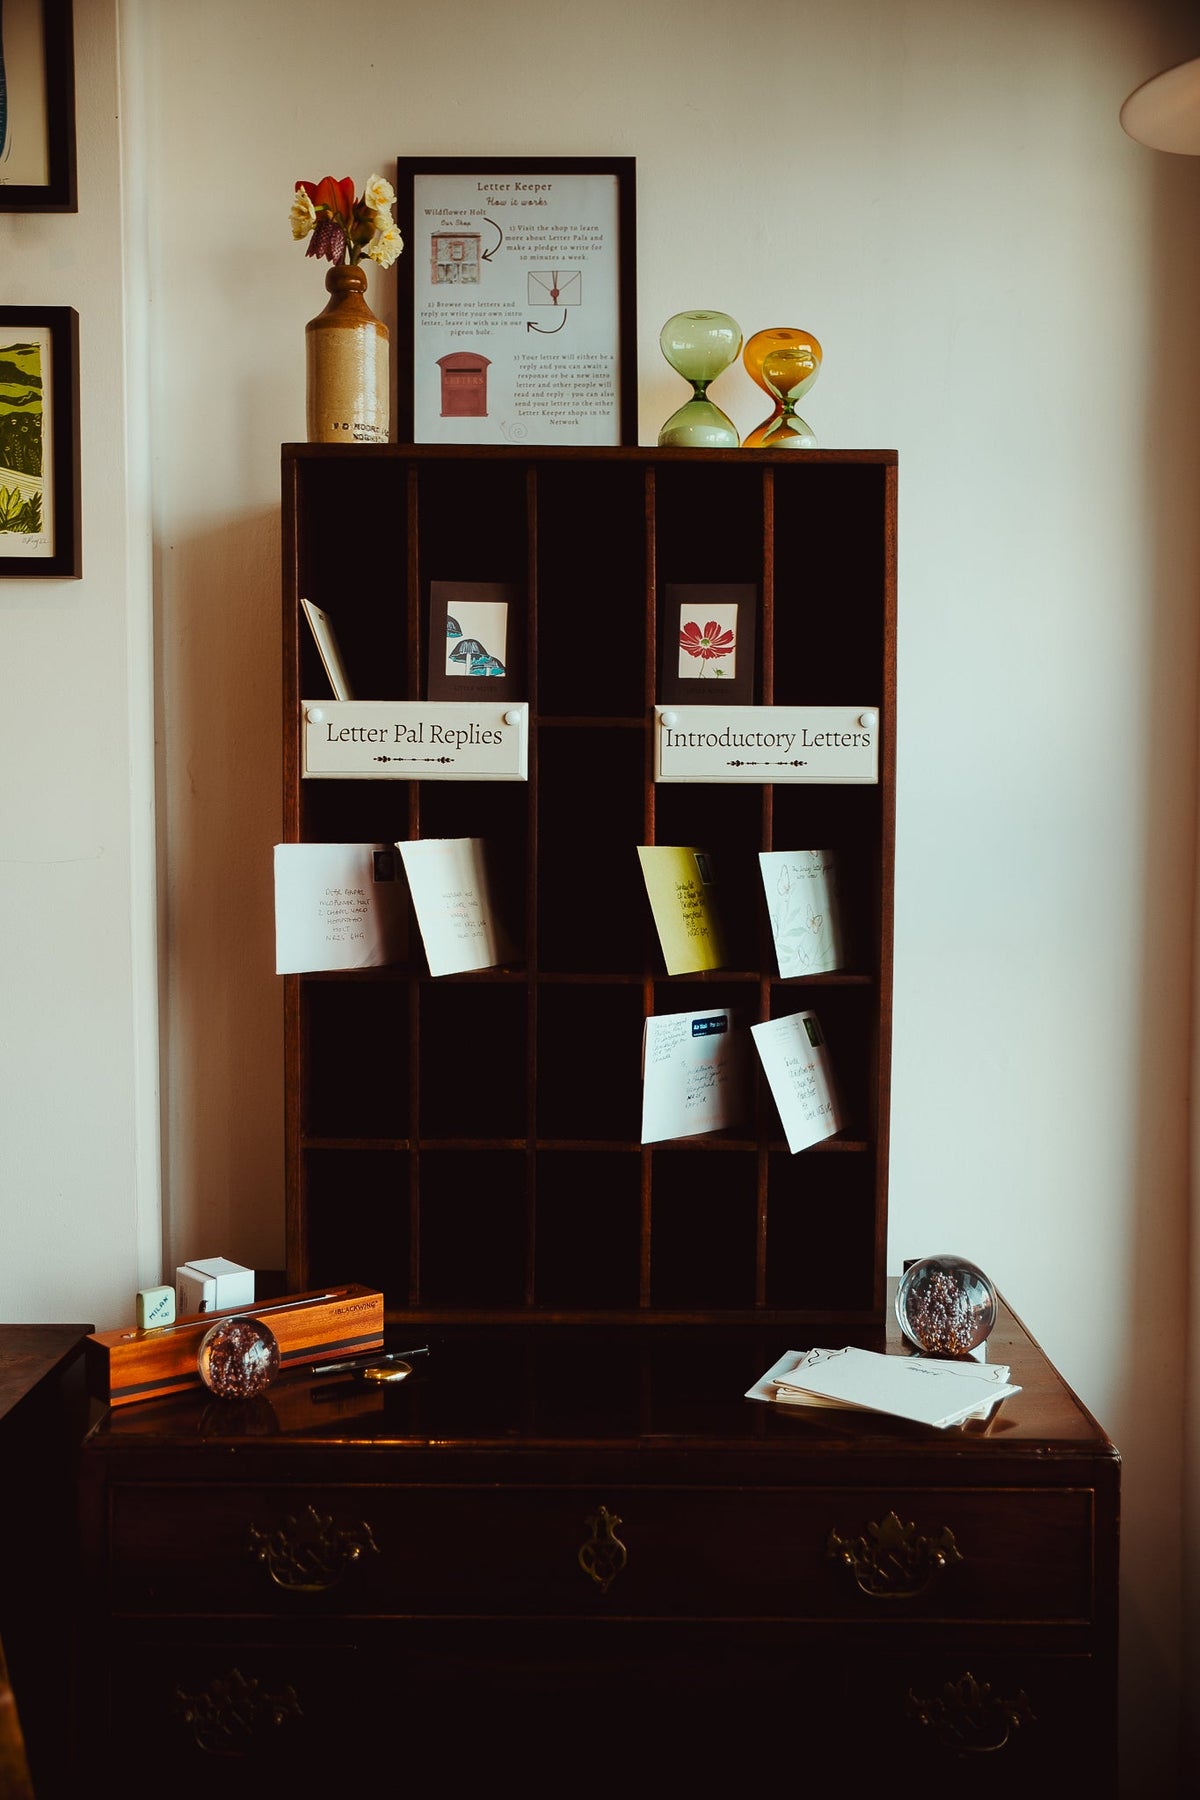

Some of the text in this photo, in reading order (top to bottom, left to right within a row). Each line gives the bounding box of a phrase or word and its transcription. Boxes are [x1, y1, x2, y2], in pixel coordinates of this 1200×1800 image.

[477, 182, 553, 194] Letter Keeper
[485, 196, 508, 207] How
[520, 196, 548, 207] works
[424, 208, 487, 216] Wildflower Holt
[455, 218, 472, 226] Shop
[517, 224, 535, 232] Visit
[536, 224, 550, 232] the
[551, 224, 569, 233] shop
[579, 224, 600, 232] learn
[506, 243, 526, 251] make
[533, 243, 558, 252] pledge
[590, 243, 603, 251] for
[477, 300, 501, 308] letters
[420, 310, 440, 319] reply
[470, 311, 487, 319] your
[521, 353, 539, 361] Your
[539, 353, 560, 361] letter
[576, 351, 598, 361] either
[519, 362, 538, 371] reply
[573, 381, 597, 390] people
[531, 390, 545, 398] and
[546, 390, 565, 399] reply
[514, 399, 532, 408] send
[581, 399, 593, 407] the
[594, 399, 614, 407] other
[518, 409, 540, 417] Letter
[541, 409, 566, 418] Keeper
[567, 409, 588, 417] shops
[549, 418, 579, 426] Network
[326, 722, 503, 749] Letter Pal Replies
[665, 726, 871, 753] Introductory Letters
[149, 1295, 168, 1320] MILAN
